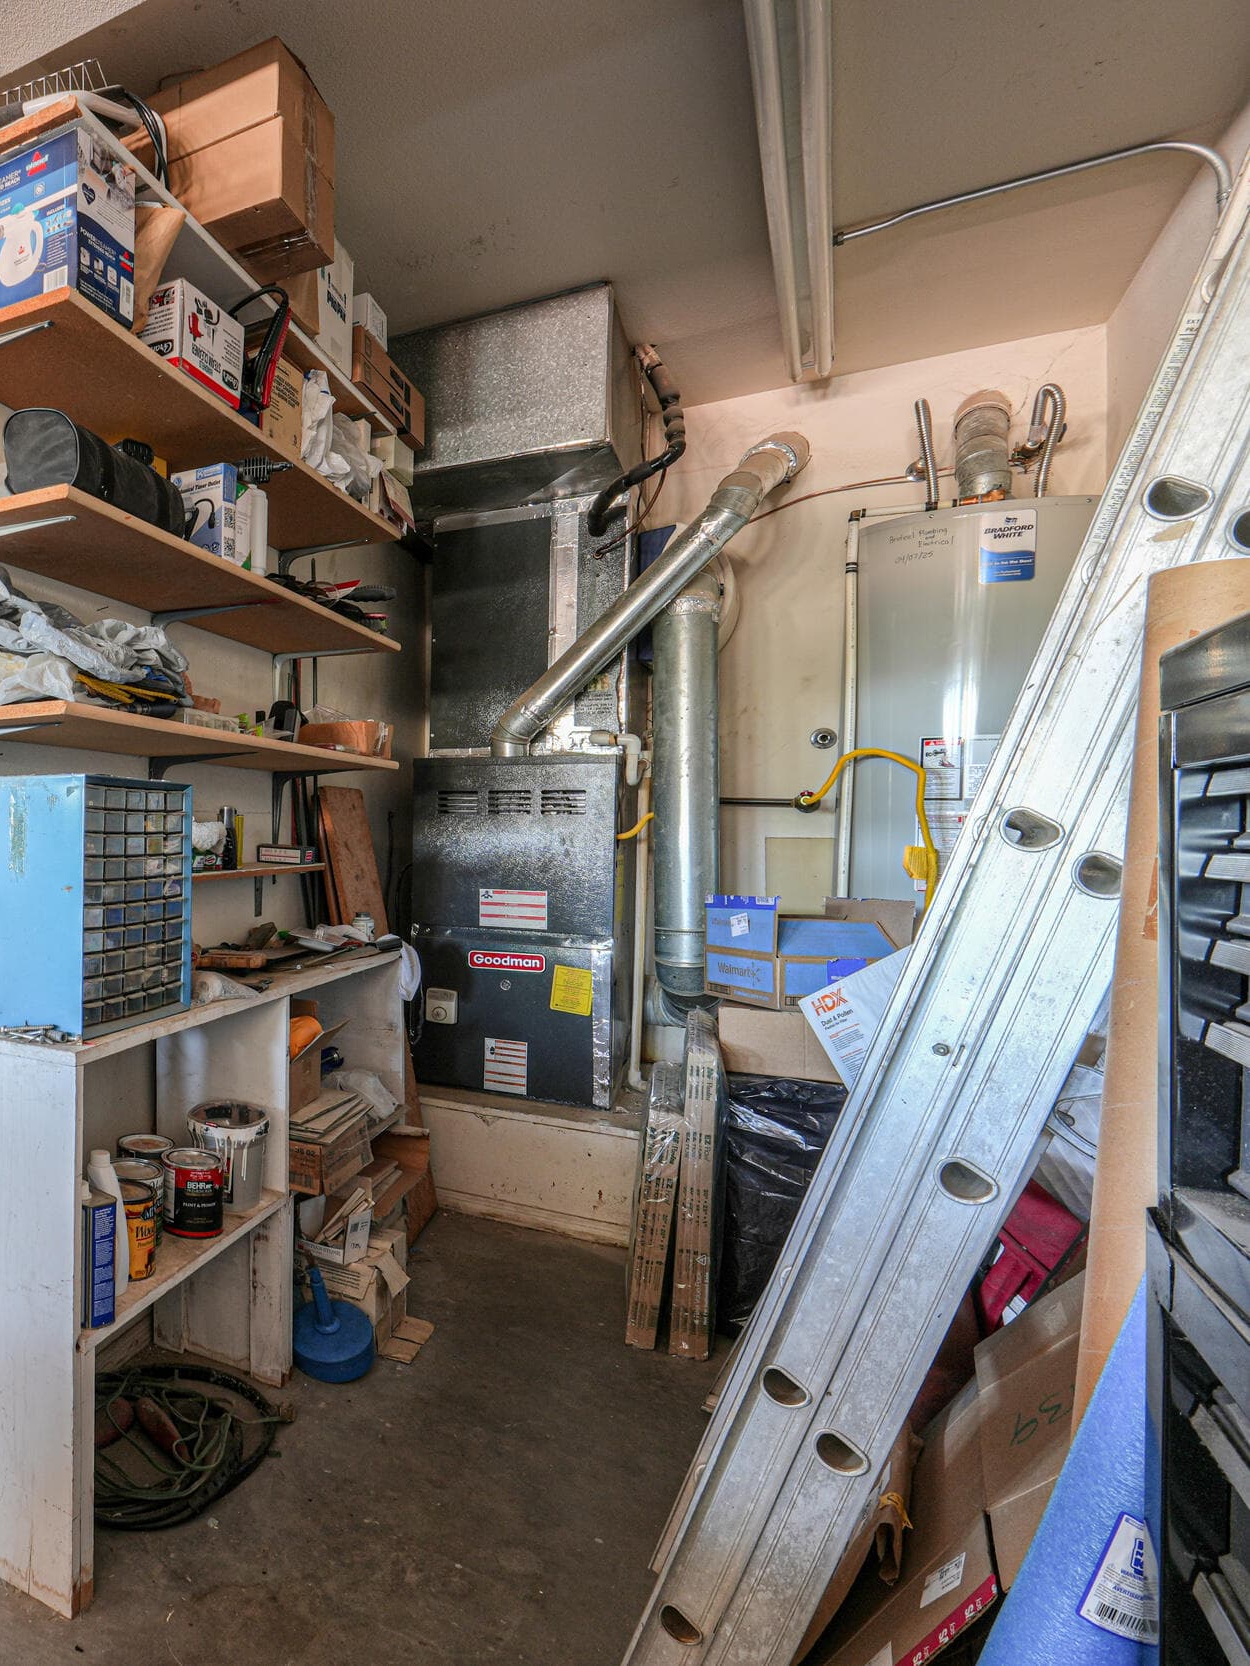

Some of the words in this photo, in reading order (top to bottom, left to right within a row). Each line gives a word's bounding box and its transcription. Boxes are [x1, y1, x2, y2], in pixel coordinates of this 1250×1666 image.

[984, 524, 1034, 534] BRADFORD
[993, 531, 1024, 539] WHITE
[473, 953, 540, 968] Goodman
[718, 962, 751, 977] Walmart
[811, 987, 849, 1017] HDX
[837, 1008, 854, 1019] Pollen
